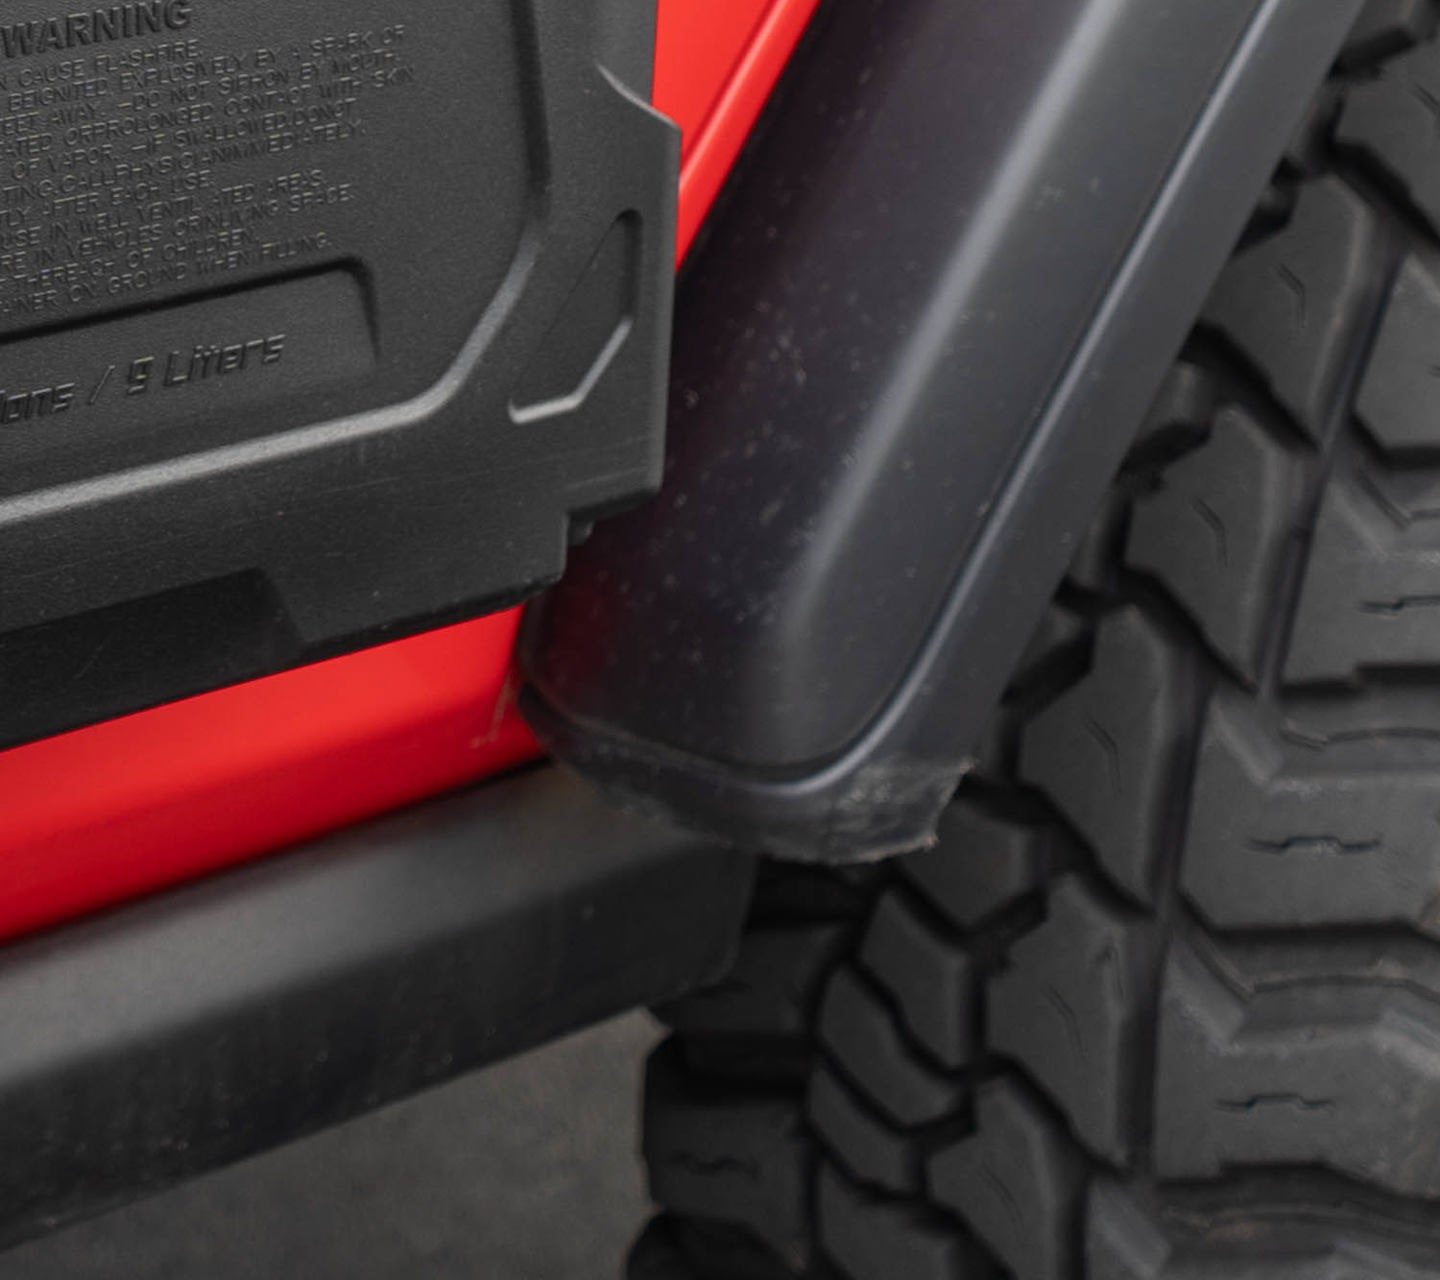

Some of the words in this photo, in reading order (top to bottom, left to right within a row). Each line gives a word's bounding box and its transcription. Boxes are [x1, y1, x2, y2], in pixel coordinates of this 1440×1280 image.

[17, 57, 85, 88] CAUSE
[170, 79, 211, 105] NOT
[14, 157, 39, 181] OF
[110, 178, 160, 206] EACH
[0, 225, 40, 251] USE
[81, 206, 130, 234] WELL
[127, 245, 154, 269] OF
[69, 278, 96, 302] ON
[107, 259, 188, 294] GROUND
[197, 246, 248, 276] WHEN
[125, 355, 155, 396] 9
[163, 333, 287, 387] Liters
